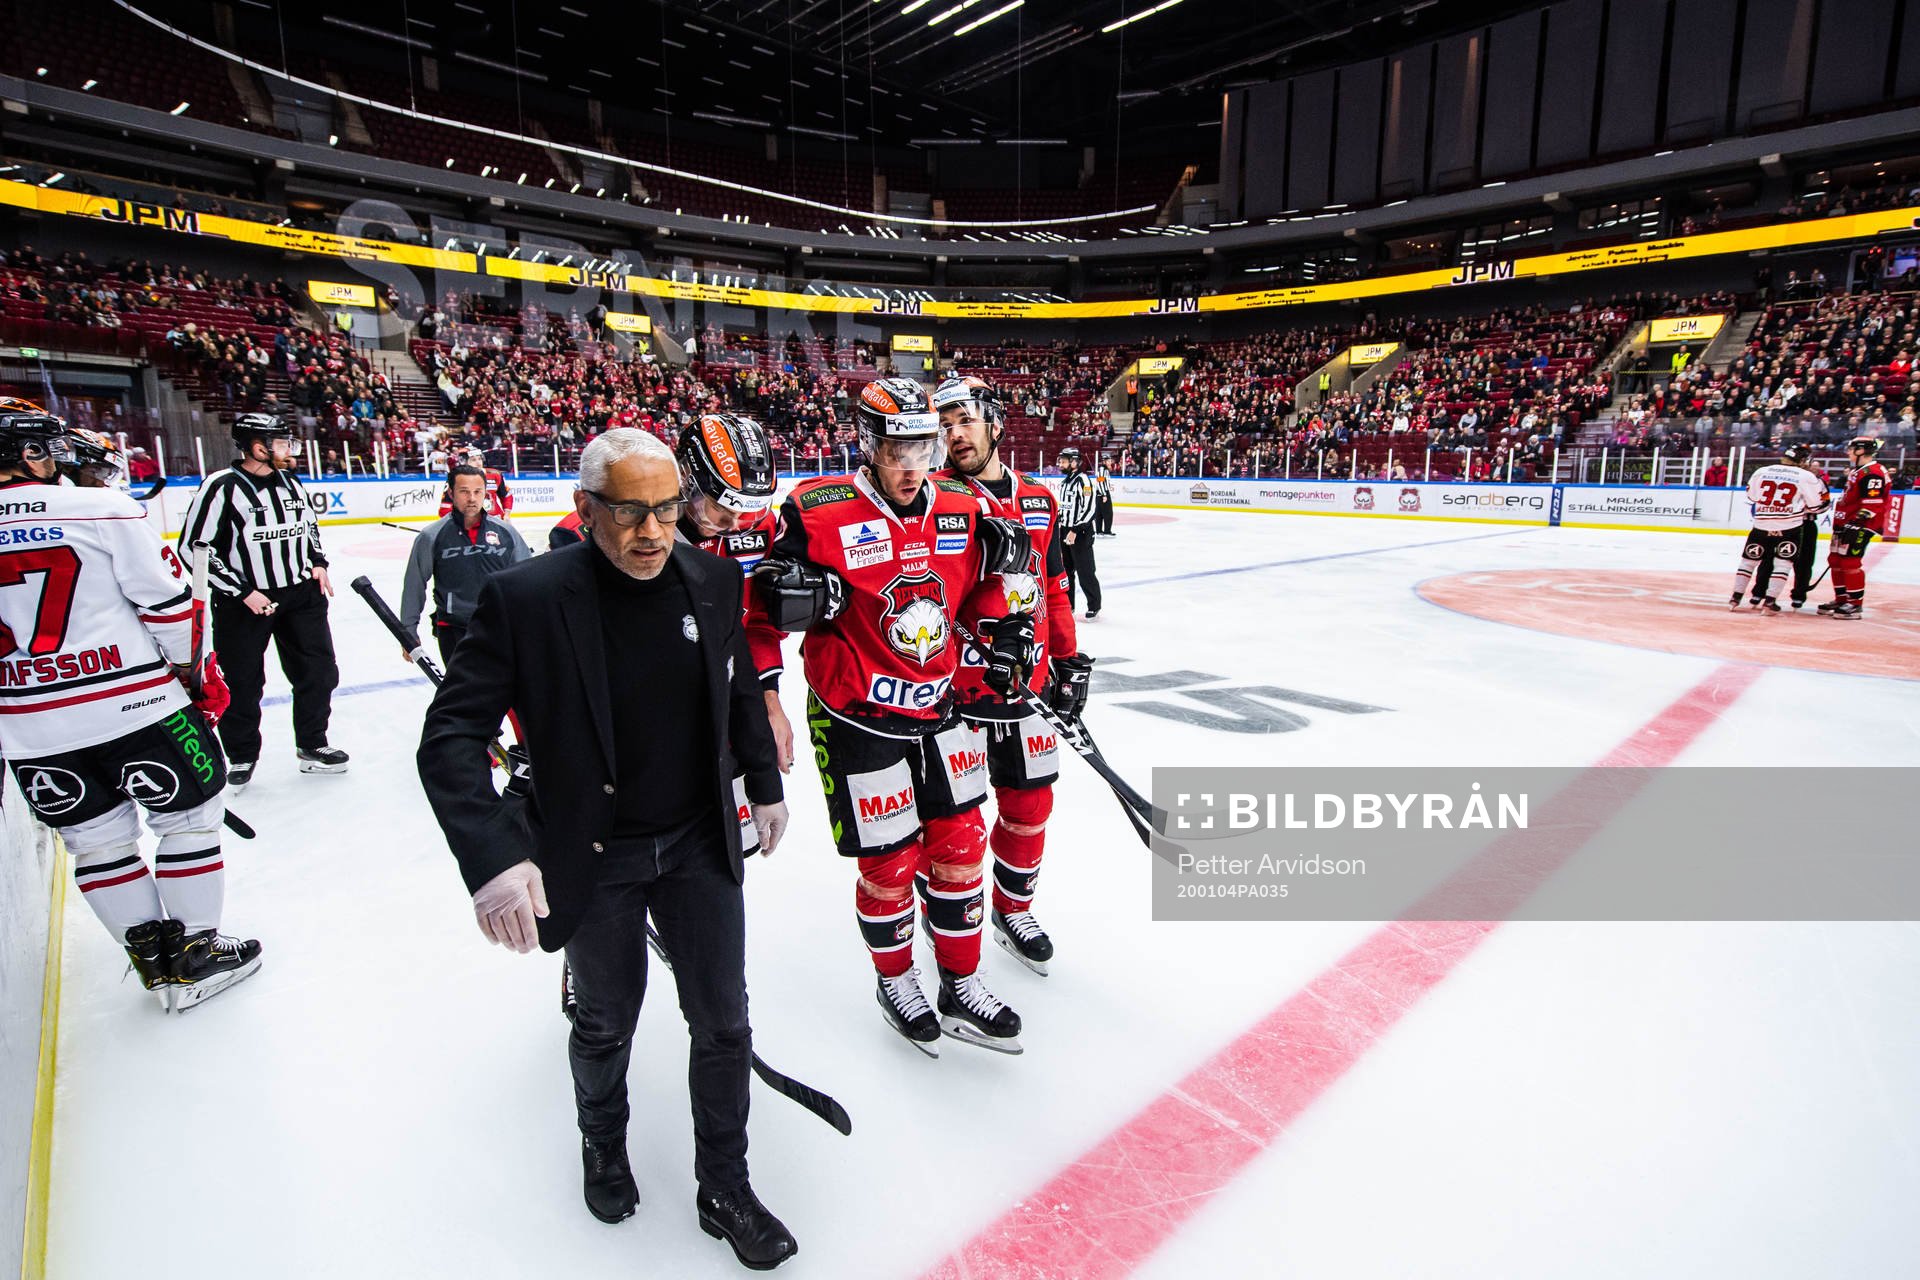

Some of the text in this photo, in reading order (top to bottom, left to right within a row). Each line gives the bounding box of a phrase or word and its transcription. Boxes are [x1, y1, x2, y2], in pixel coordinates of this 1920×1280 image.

[102, 200, 199, 233] JPM
[1452, 260, 1514, 285] JPM
[569, 269, 627, 291] JPM
[330, 287, 352, 296] JPM
[873, 299, 921, 315] JPM
[1150, 298, 1199, 313] JPM
[619, 317, 635, 325] JPM
[1673, 320, 1697, 332] JPM
[1365, 347, 1382, 357] JPM
[756, 472, 766, 482] 14
[1867, 479, 1882, 489] 63
[802, 485, 851, 501] GRÖNSAKS
[818, 492, 847, 503] HUSET
[1210, 488, 1236, 497] NORDANÅ
[1259, 489, 1336, 502] montagepunkten
[1759, 480, 1798, 506] 33
[285, 500, 305, 510] SHL
[1022, 499, 1049, 509] RSA
[1210, 498, 1251, 506] GRUSTERMINAL
[1442, 492, 1543, 510] sandberg
[1551, 488, 1560, 519] CCM
[1606, 495, 1653, 505] MALMÖ
[903, 517, 919, 525] SHL
[1888, 497, 1900, 533] CCM
[938, 517, 966, 529] RSA
[252, 523, 306, 541] swedol
[700, 540, 714, 549] SHL
[729, 535, 765, 550] RSA
[904, 541, 926, 549] CCM
[441, 544, 507, 559] CCM
[849, 543, 889, 559] Prioritet
[856, 554, 885, 567] Finans
[121, 695, 167, 712] BAUER
[859, 787, 913, 818] MAXI
